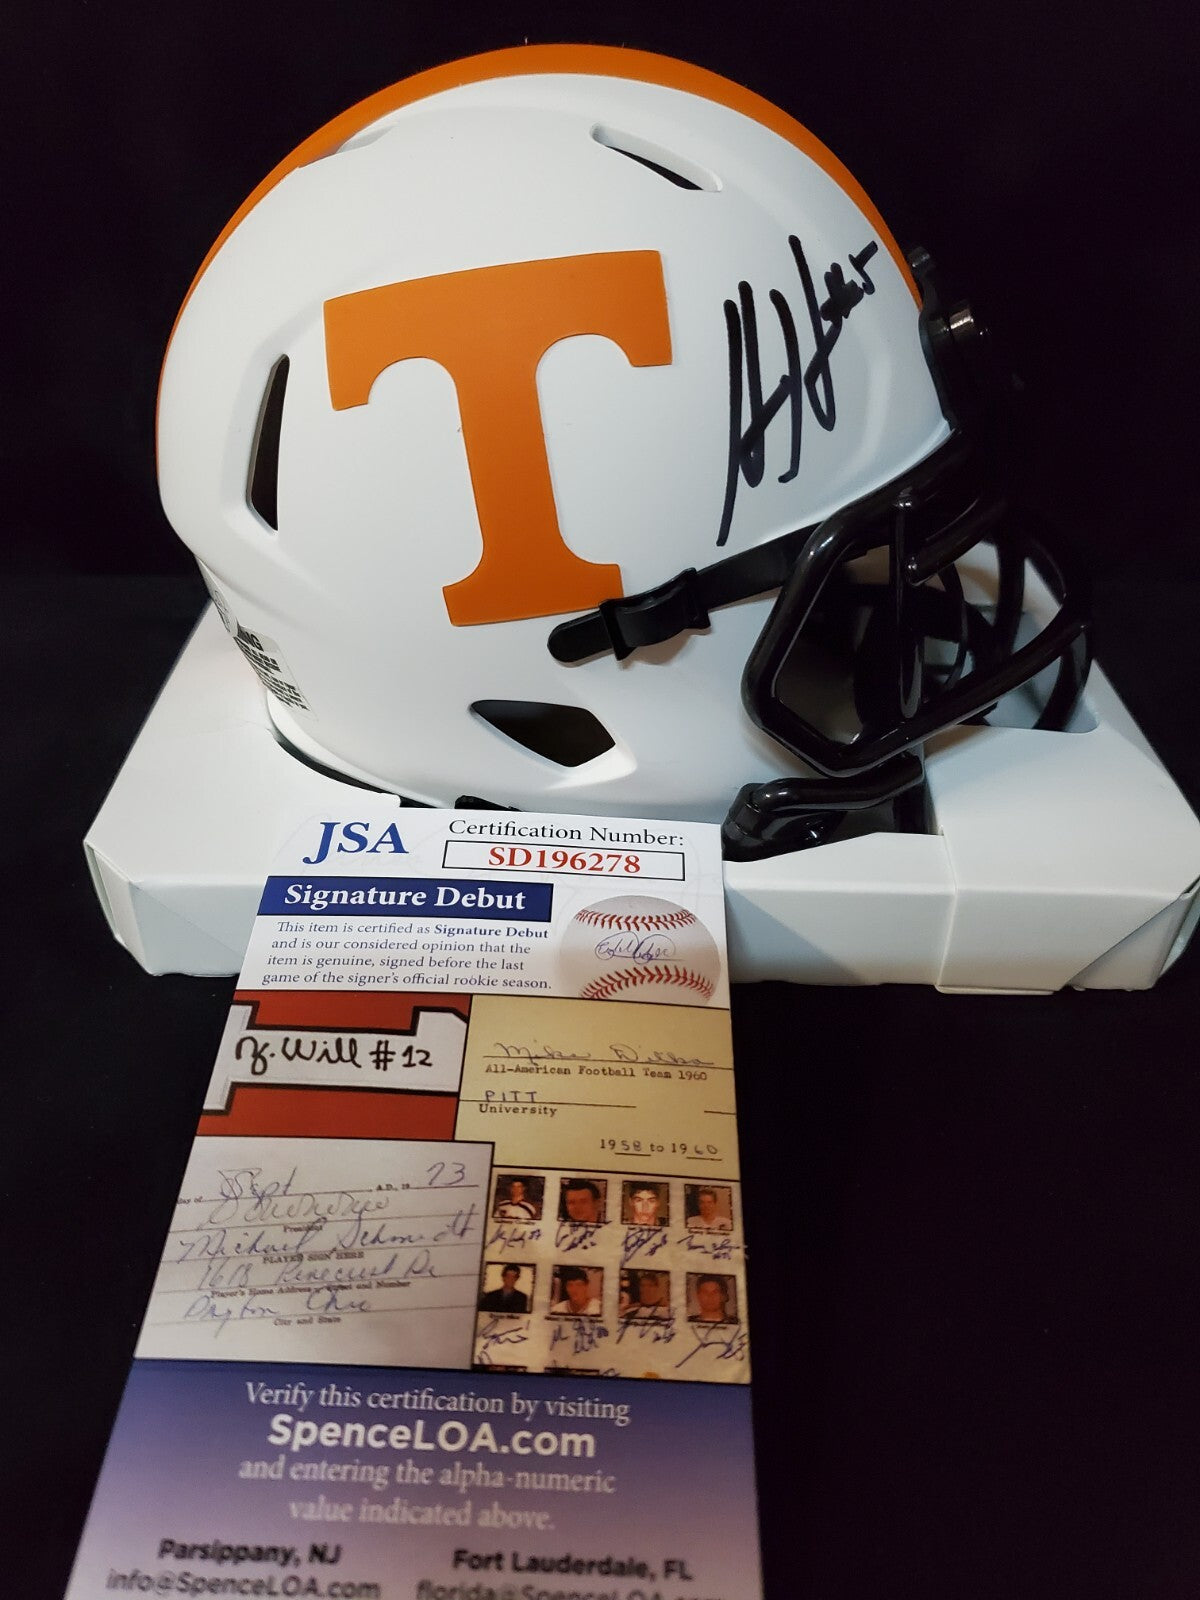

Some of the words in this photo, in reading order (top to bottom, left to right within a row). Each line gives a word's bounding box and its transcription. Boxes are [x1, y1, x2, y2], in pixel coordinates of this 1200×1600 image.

[302, 821, 410, 865] JSA
[449, 819, 582, 840] Certification
[590, 826, 685, 846] Number:
[488, 846, 641, 873] SD196278
[285, 883, 427, 911] Signature
[433, 886, 526, 909] Debut
[278, 921, 305, 933] This
[308, 922, 339, 933] item
[342, 922, 354, 934] is
[357, 922, 413, 934] certified
[416, 925, 430, 935] as
[434, 924, 502, 938] Signature
[505, 926, 549, 939] Debut
[271, 938, 298, 950] and
[301, 938, 312, 949] is
[315, 940, 341, 950] our
[343, 939, 418, 951] considered
[421, 940, 475, 954] opinion
[479, 941, 505, 953] that
[509, 942, 531, 955] the
[267, 954, 298, 966] item
[301, 955, 313, 966] is
[315, 956, 375, 969] genuine,
[379, 955, 425, 970] signed
[428, 956, 472, 969] before
[475, 957, 498, 970] the
[500, 959, 525, 971] last
[261, 972, 300, 986] game
[303, 971, 320, 983] of
[322, 971, 344, 983] the
[402, 972, 450, 985] official
[453, 974, 499, 987] rookie
[501, 977, 552, 990] season.
[281, 1037, 362, 1069] Will
[485, 1063, 571, 1076] All-American
[577, 1064, 636, 1078] Football
[643, 1067, 672, 1080] Team
[678, 1069, 708, 1082] 1960
[485, 1089, 538, 1103] PITT
[479, 1103, 558, 1118] University
[650, 1144, 665, 1153] to
[246, 1382, 314, 1412] Verify
[319, 1384, 361, 1407] this
[367, 1387, 504, 1413] certification
[511, 1392, 538, 1421] by
[544, 1396, 631, 1426] visiting
[267, 1413, 596, 1458] SpenceLOA.com
[238, 1454, 286, 1480] and
[289, 1458, 389, 1490] entering
[396, 1459, 434, 1485] the
[438, 1461, 617, 1493] alpha-numeric
[290, 1495, 353, 1522] value
[358, 1497, 472, 1526] indicated
[477, 1501, 555, 1530] above.
[158, 1538, 300, 1567] Parsippany,
[308, 1542, 342, 1564] NJ
[453, 1549, 504, 1572] Fort
[511, 1551, 656, 1582] Lauderdale,
[664, 1558, 694, 1581] FL
[106, 1568, 381, 1599] info@SpenceLOA.com
